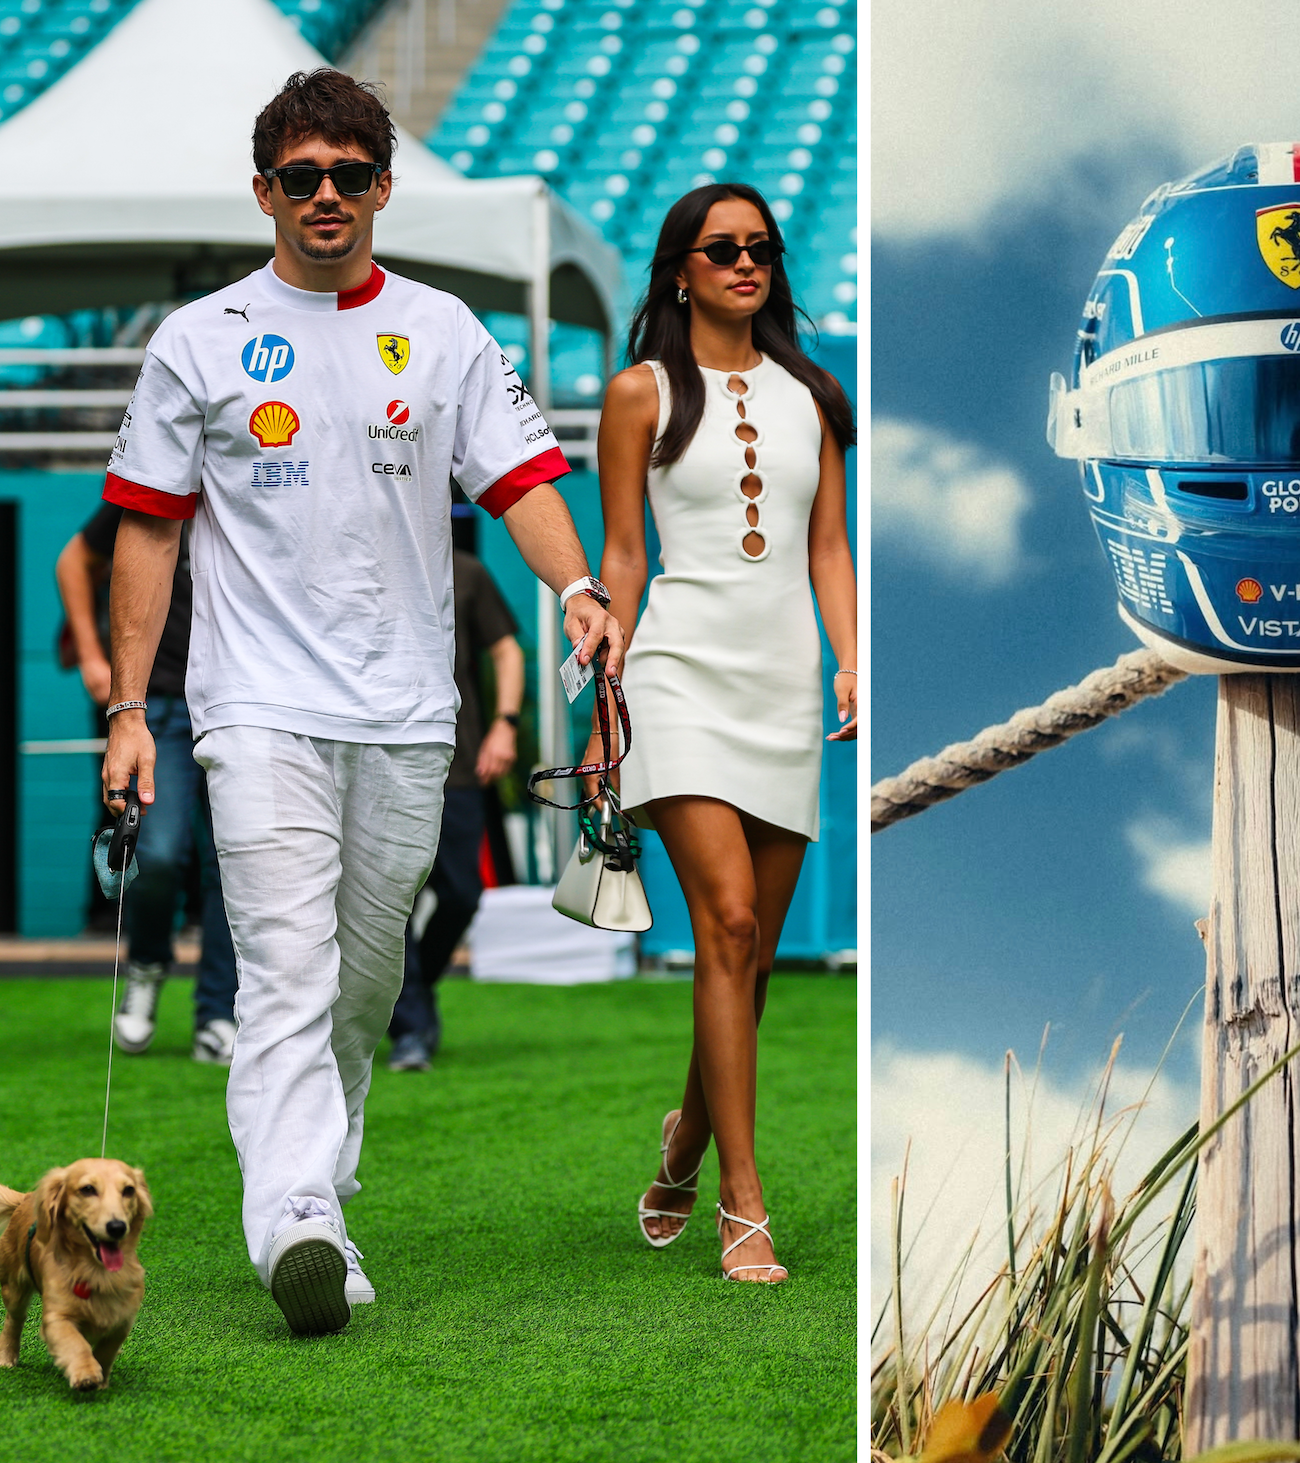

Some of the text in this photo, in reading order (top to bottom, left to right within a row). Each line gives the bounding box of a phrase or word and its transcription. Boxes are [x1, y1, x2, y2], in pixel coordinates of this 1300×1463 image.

[248, 334, 289, 383] hp
[1124, 348, 1159, 367] MILLE
[251, 461, 309, 487] IBM
[1107, 539, 1174, 614] IBM
